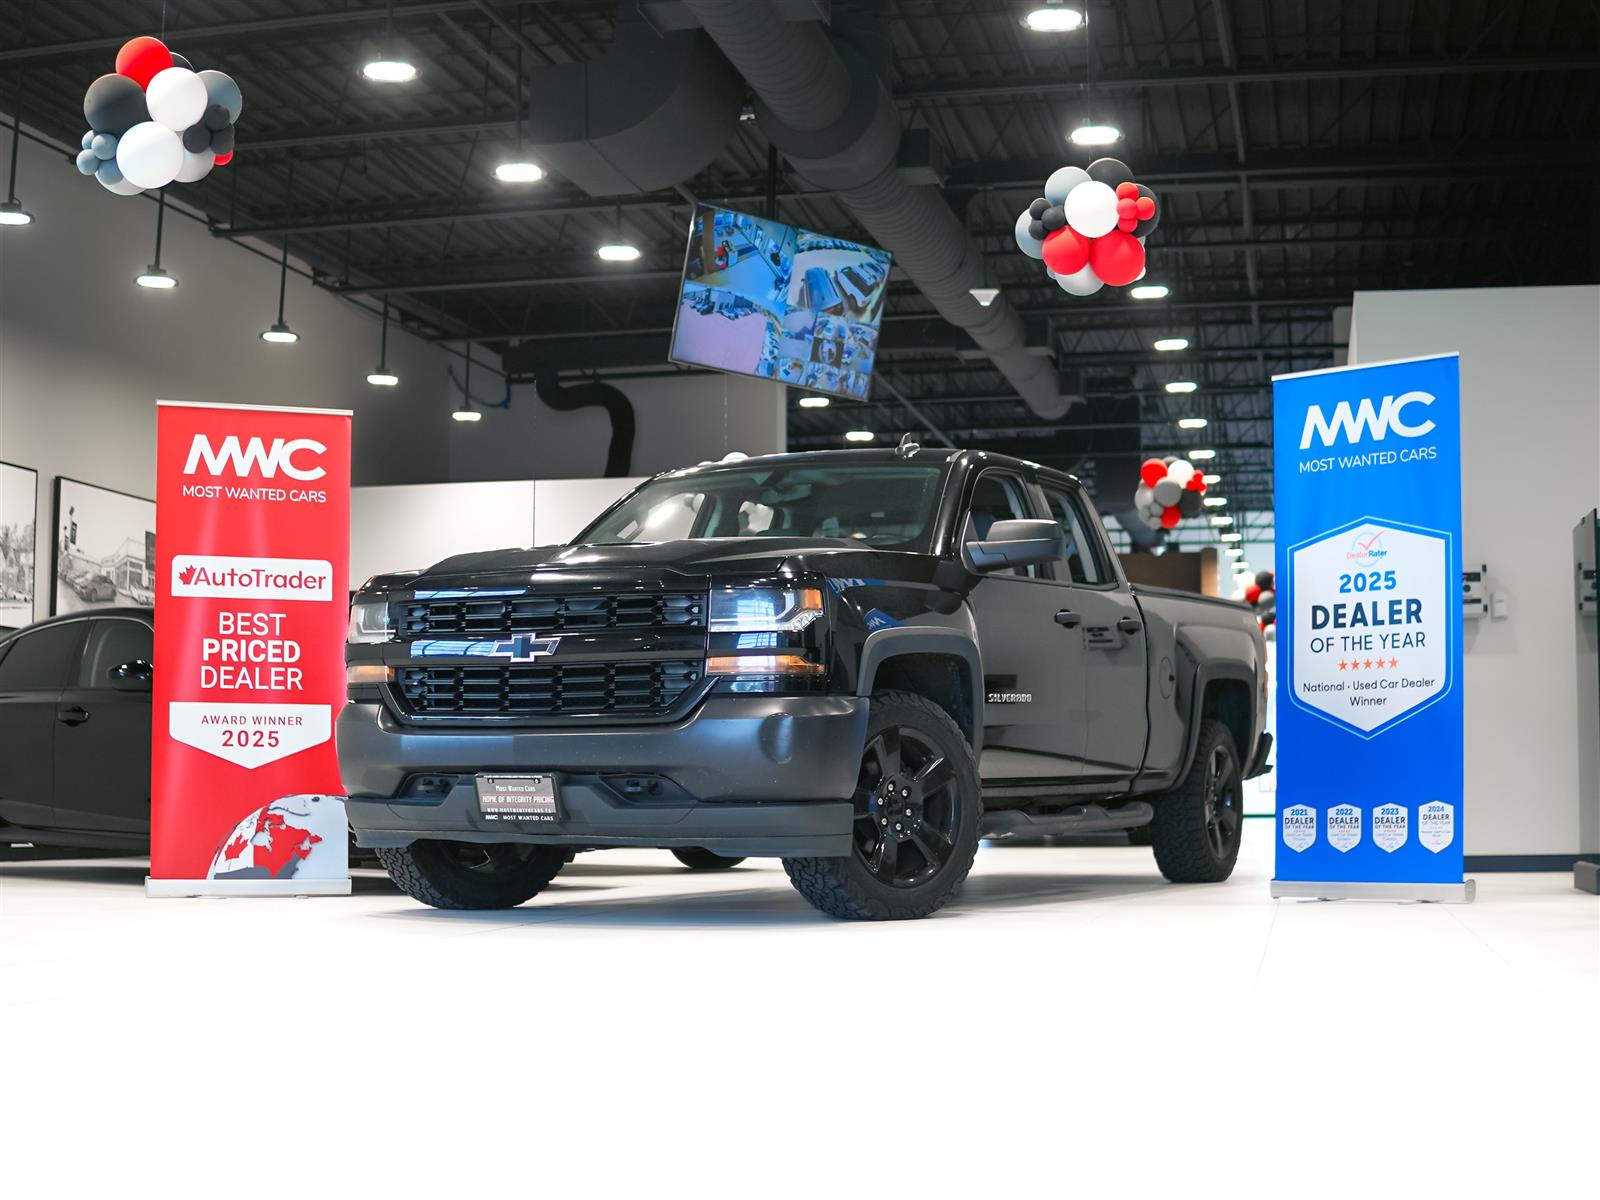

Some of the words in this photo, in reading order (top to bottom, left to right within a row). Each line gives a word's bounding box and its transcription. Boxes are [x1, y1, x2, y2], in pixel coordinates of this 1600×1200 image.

[1299, 391, 1437, 450] MWC
[183, 433, 327, 481] MWC
[1299, 457, 1335, 474] MOST
[1338, 451, 1397, 469] WANTED
[1400, 446, 1437, 462] CARS
[182, 485, 222, 498] MOST
[225, 486, 286, 501] WANTED
[289, 489, 326, 503] CARS
[193, 566, 326, 589] AutoTrader
[1339, 570, 1397, 593] 2025
[1311, 598, 1423, 630] DEALER
[219, 611, 286, 636] BEST
[202, 638, 301, 663] PRICED
[1310, 637, 1335, 653] OF
[1341, 634, 1373, 651] THE
[1379, 631, 1426, 649] YEAR
[200, 666, 303, 690] DEALER
[1303, 681, 1345, 692] National
[1352, 679, 1378, 691] Used
[1380, 679, 1398, 690] Car
[1401, 677, 1435, 689] Dealer
[988, 693, 1032, 703] SILVERADO
[1350, 696, 1388, 707] Winner
[201, 715, 247, 725] AWARD
[252, 716, 303, 726] WINNER
[222, 730, 279, 747] 2025
[482, 795, 497, 803] HOME
[498, 795, 505, 803] OF
[1290, 808, 1308, 816] 2021
[1374, 816, 1406, 824] DEALER
[1422, 813, 1450, 821] DEALER
[1284, 817, 1314, 825] DEALER
[1329, 817, 1359, 825] DEALER
